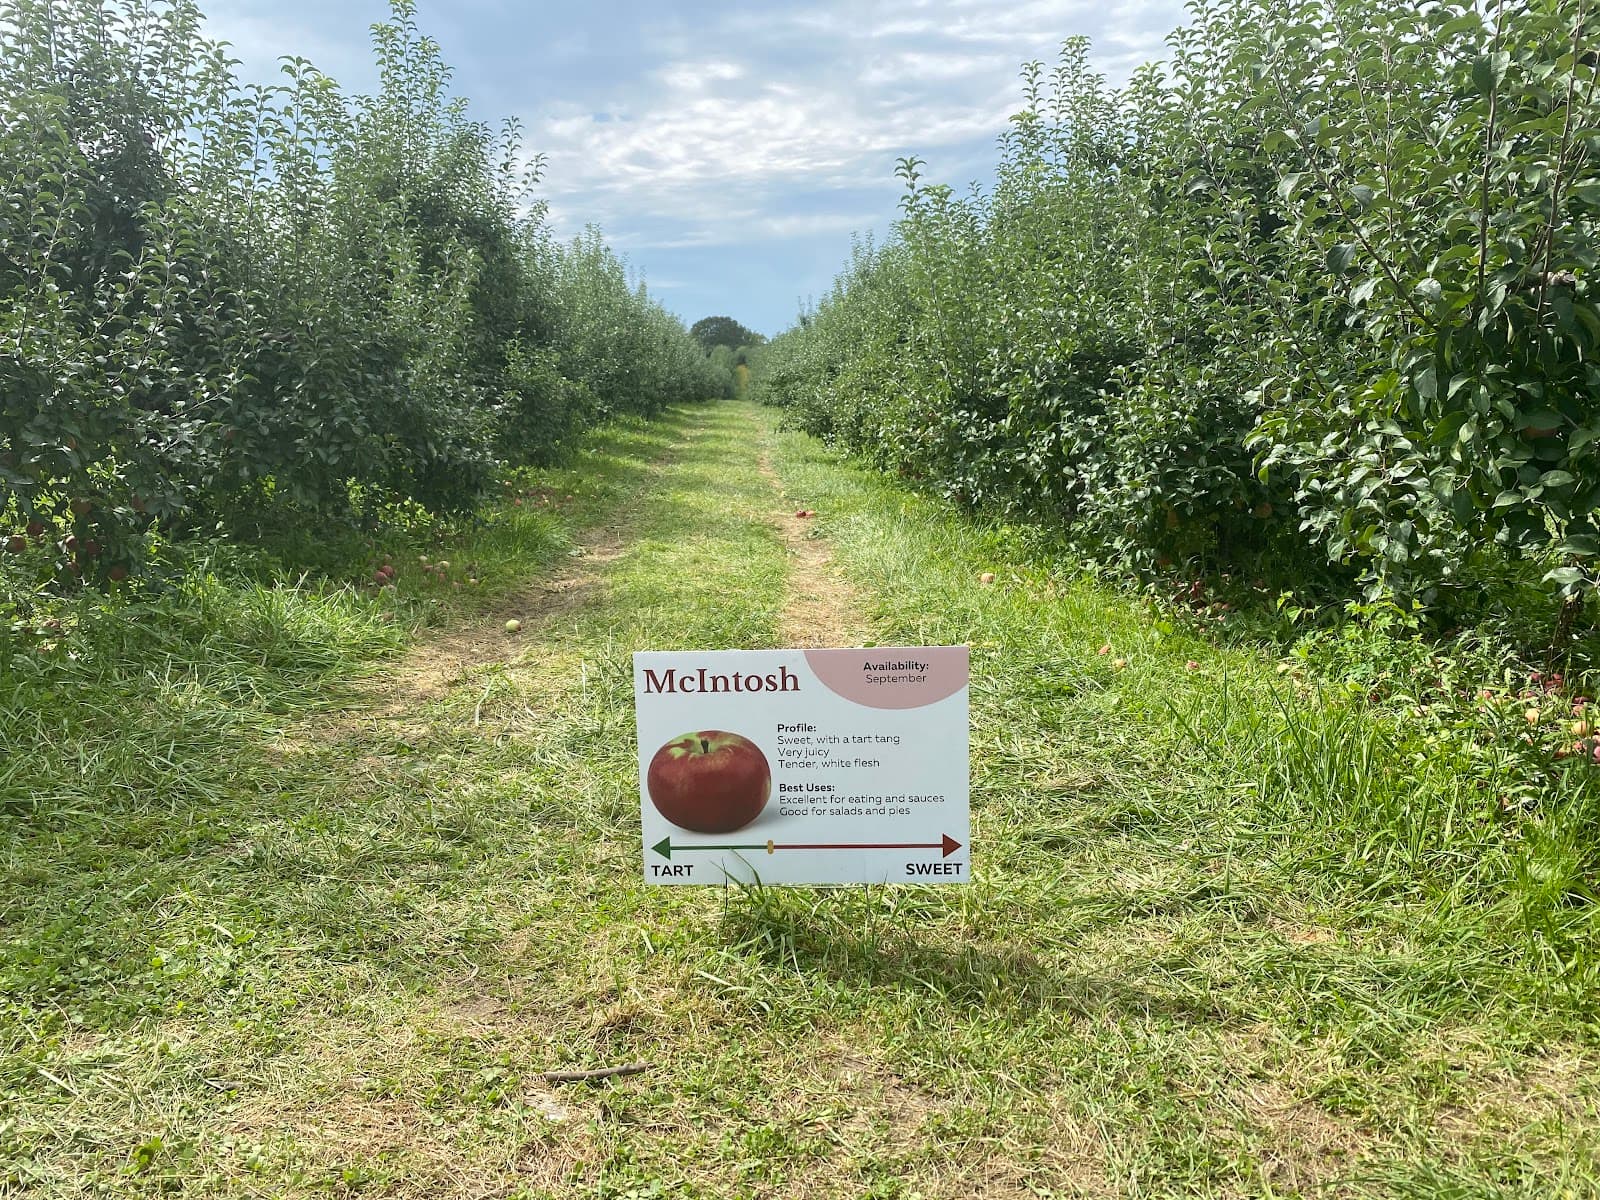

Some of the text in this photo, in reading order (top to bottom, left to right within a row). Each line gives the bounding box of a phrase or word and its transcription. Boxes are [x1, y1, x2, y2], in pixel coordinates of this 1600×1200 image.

[863, 661, 929, 673] Availability:
[642, 666, 801, 694] McIntosh
[865, 673, 927, 686] September
[777, 723, 817, 733] Profile:
[777, 735, 813, 746] Sweet,
[816, 734, 840, 744] with
[852, 735, 873, 744] tart
[875, 734, 901, 746] tang
[777, 747, 830, 758] Very juicy
[777, 758, 880, 770] Tender, white flesh
[779, 783, 836, 793] Best Uses:
[779, 793, 945, 806] Excellent for eating and sauces
[779, 805, 911, 818] Good for salads and pies
[651, 864, 694, 877] TART
[905, 863, 963, 876] SWEET
